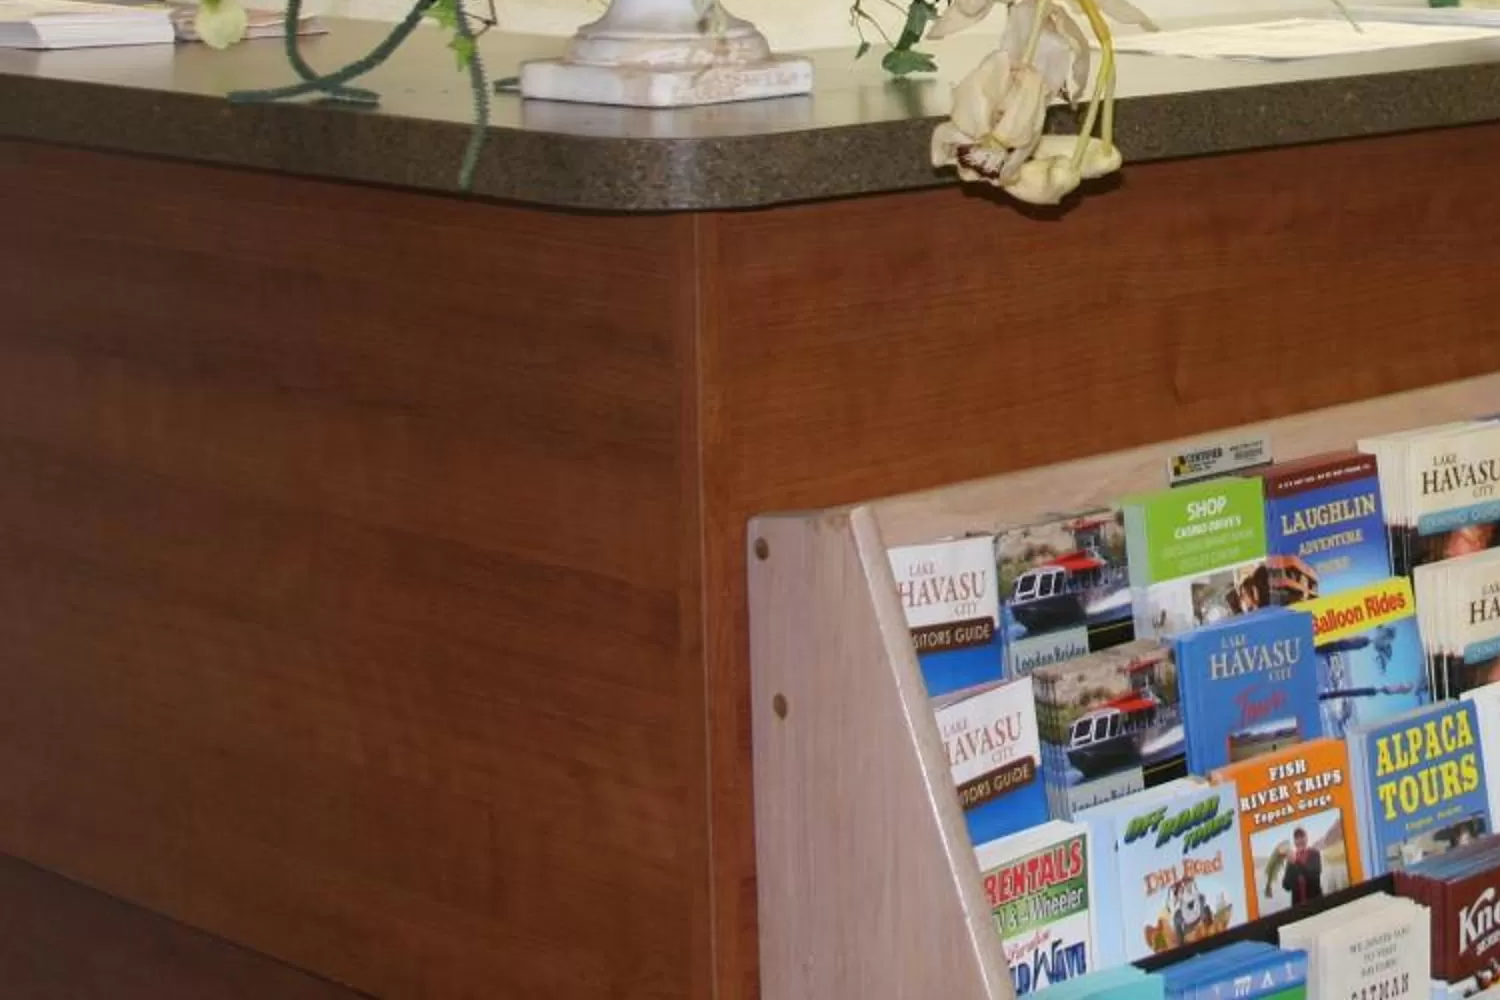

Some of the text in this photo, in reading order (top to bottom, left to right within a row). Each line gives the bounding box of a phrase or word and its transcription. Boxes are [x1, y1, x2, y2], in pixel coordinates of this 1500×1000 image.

[1432, 453, 1457, 467] LAKE
[1472, 484, 1494, 499] CITY
[1187, 495, 1227, 521] SHOP
[1280, 493, 1376, 536] LAUGHLIN
[909, 562, 935, 577] LAKE
[899, 570, 986, 607] HAVASU
[1364, 592, 1407, 620] Rides
[955, 623, 991, 643] GUIDE
[1210, 637, 1301, 681] HAVASU
[1376, 710, 1474, 777] ALPACA
[994, 764, 1030, 791] GUIDE
[1268, 759, 1307, 781] FISH
[1240, 769, 1342, 812] RIVER TRIPS
[1377, 752, 1479, 821] TOURS
[984, 839, 1083, 907] RENTALS
